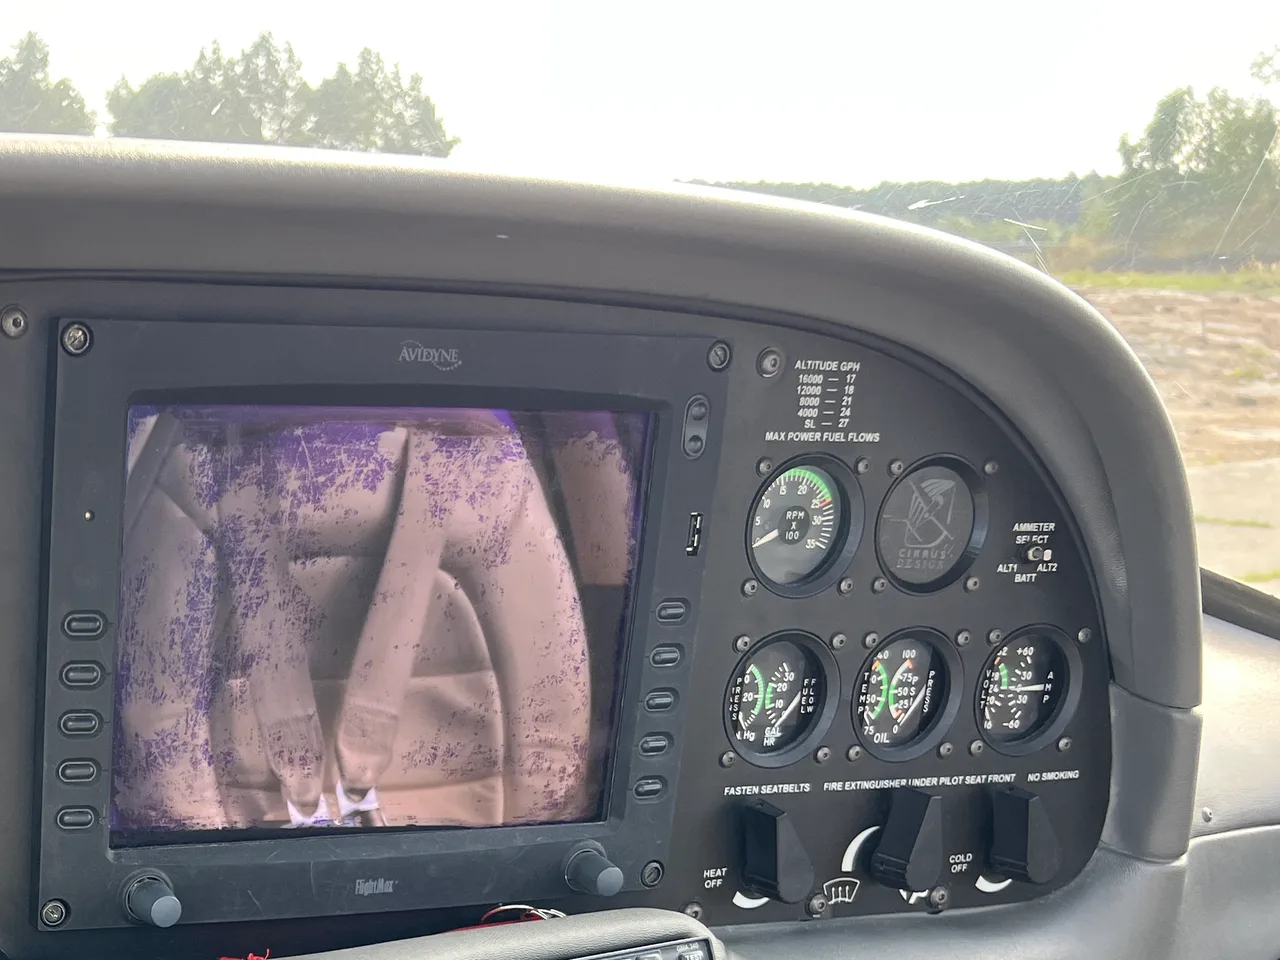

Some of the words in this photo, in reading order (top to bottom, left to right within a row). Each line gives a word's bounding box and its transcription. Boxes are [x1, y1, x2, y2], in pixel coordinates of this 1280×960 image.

[398, 346, 459, 362] AVIDYNE
[794, 360, 839, 371] ALTITUDE
[840, 361, 861, 372] GPH
[765, 432, 786, 441] MAX
[787, 432, 822, 442] POWER
[822, 432, 846, 442] FUEL
[847, 433, 880, 442] FLOWS
[786, 511, 805, 520] RPM
[791, 521, 796, 530] X
[1013, 523, 1056, 532] AMMETER
[785, 531, 800, 540] 100
[997, 563, 1018, 573] ALT1
[1037, 563, 1058, 572] ALT2
[1014, 574, 1037, 583] BATT
[764, 727, 780, 736] GAL
[874, 733, 890, 744] OIL
[1027, 772, 1040, 782] NO
[1041, 770, 1080, 782] SMOKING
[823, 781, 843, 791] FIRE
[844, 779, 907, 791] EXTINGUISHER
[938, 775, 963, 786] PILOT
[964, 774, 987, 785] SEAT
[988, 773, 1017, 784] FRONT
[724, 785, 759, 795] FASTEN
[760, 783, 810, 794] SEATBELTS
[949, 853, 973, 864] COLD
[703, 867, 728, 879] HEAT
[950, 863, 968, 874] OFF
[704, 878, 724, 889] OFF
